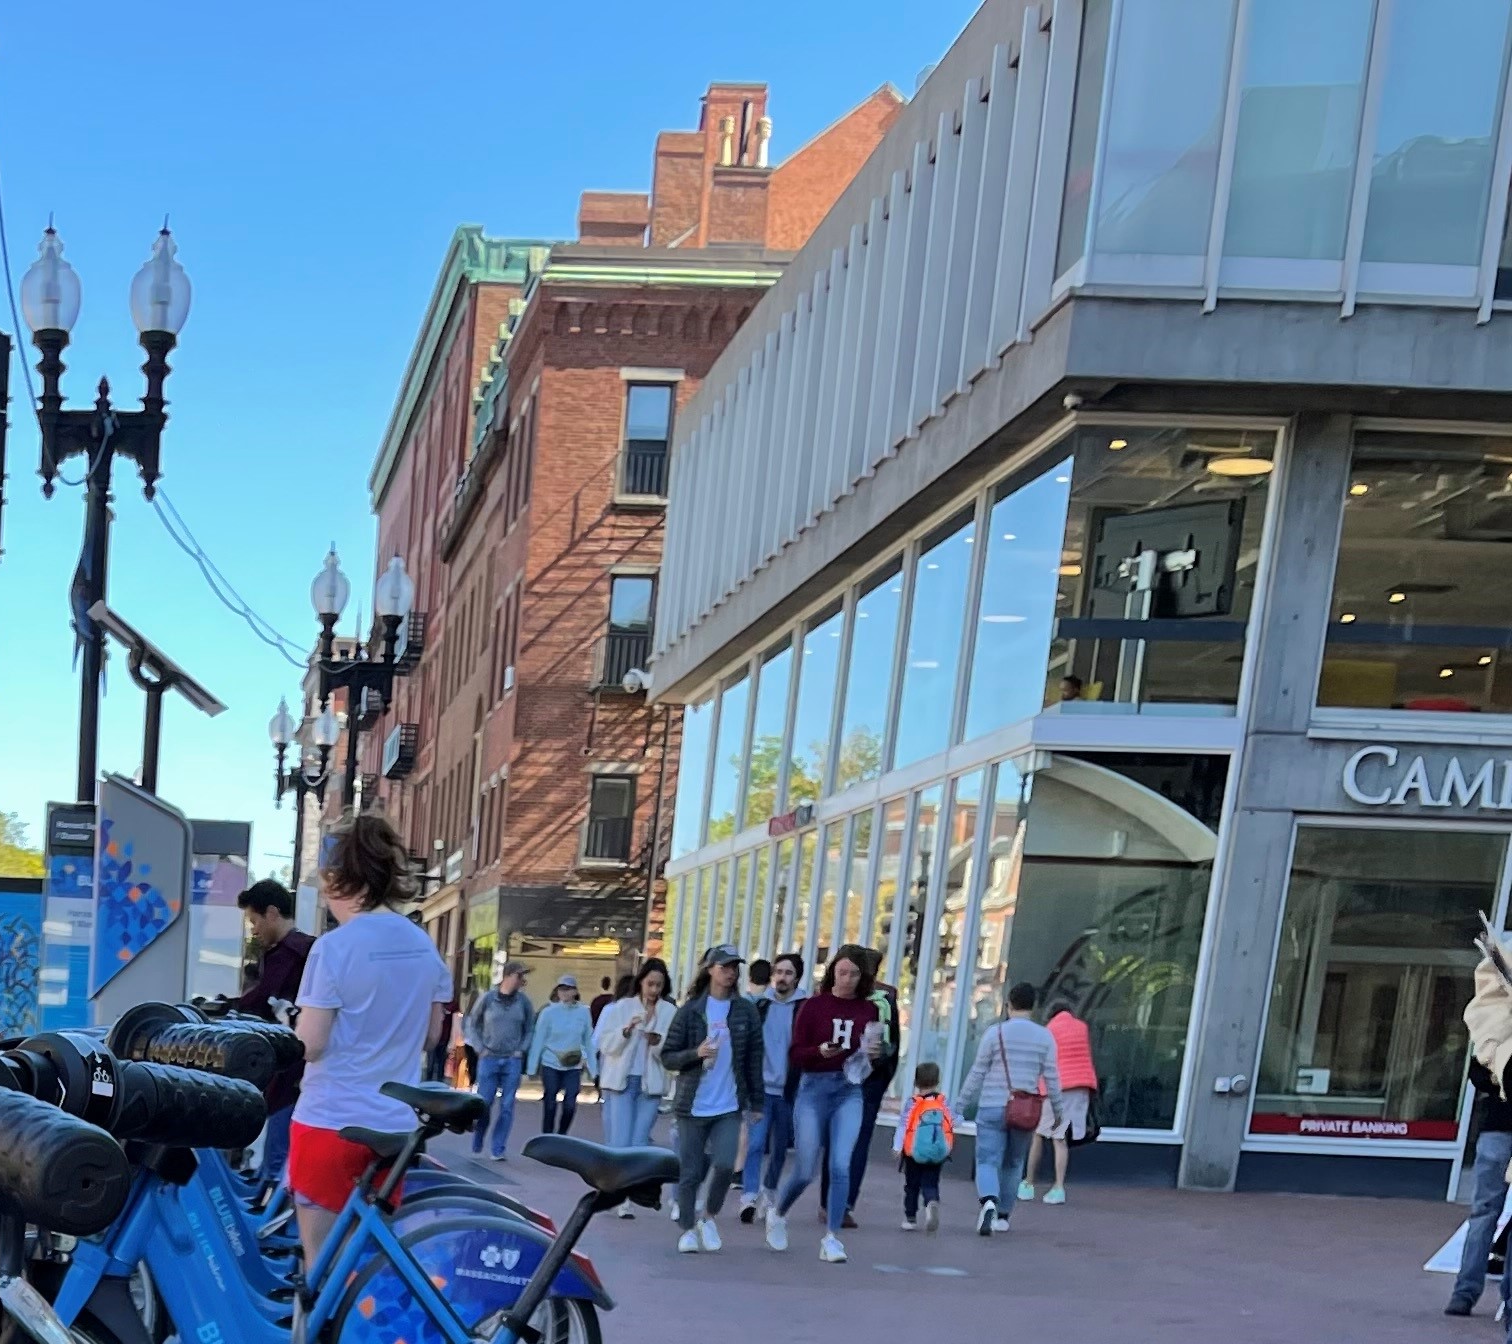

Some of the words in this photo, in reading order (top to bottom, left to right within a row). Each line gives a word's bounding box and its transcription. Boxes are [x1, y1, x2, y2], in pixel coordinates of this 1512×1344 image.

[1342, 744, 1512, 810] CAM
[832, 1018, 855, 1050] H
[1299, 1119, 1351, 1134] PRIVATE
[1351, 1120, 1408, 1136] BANKING
